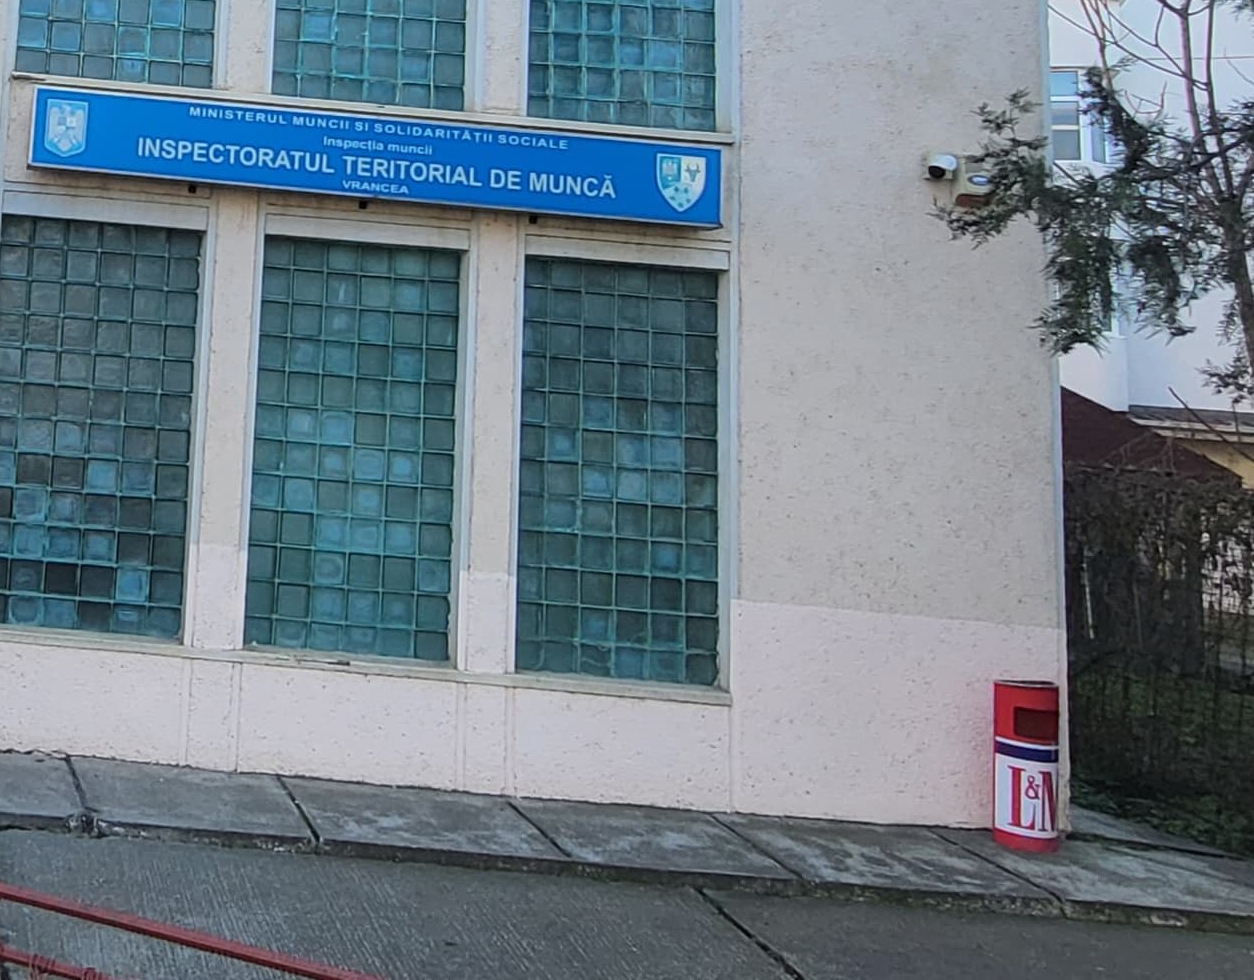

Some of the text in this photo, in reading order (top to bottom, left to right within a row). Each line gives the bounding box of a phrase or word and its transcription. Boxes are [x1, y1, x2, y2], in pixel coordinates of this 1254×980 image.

[189, 106, 288, 125] MINISTERUL
[293, 116, 349, 130] MUNCII
[497, 134, 569, 150] SOCIALE
[387, 143, 433, 155] muncii
[138, 137, 617, 199] INSPECTORATUL TERITORIAL DE MUNCĂ
[342, 180, 409, 194] VRANCEA
